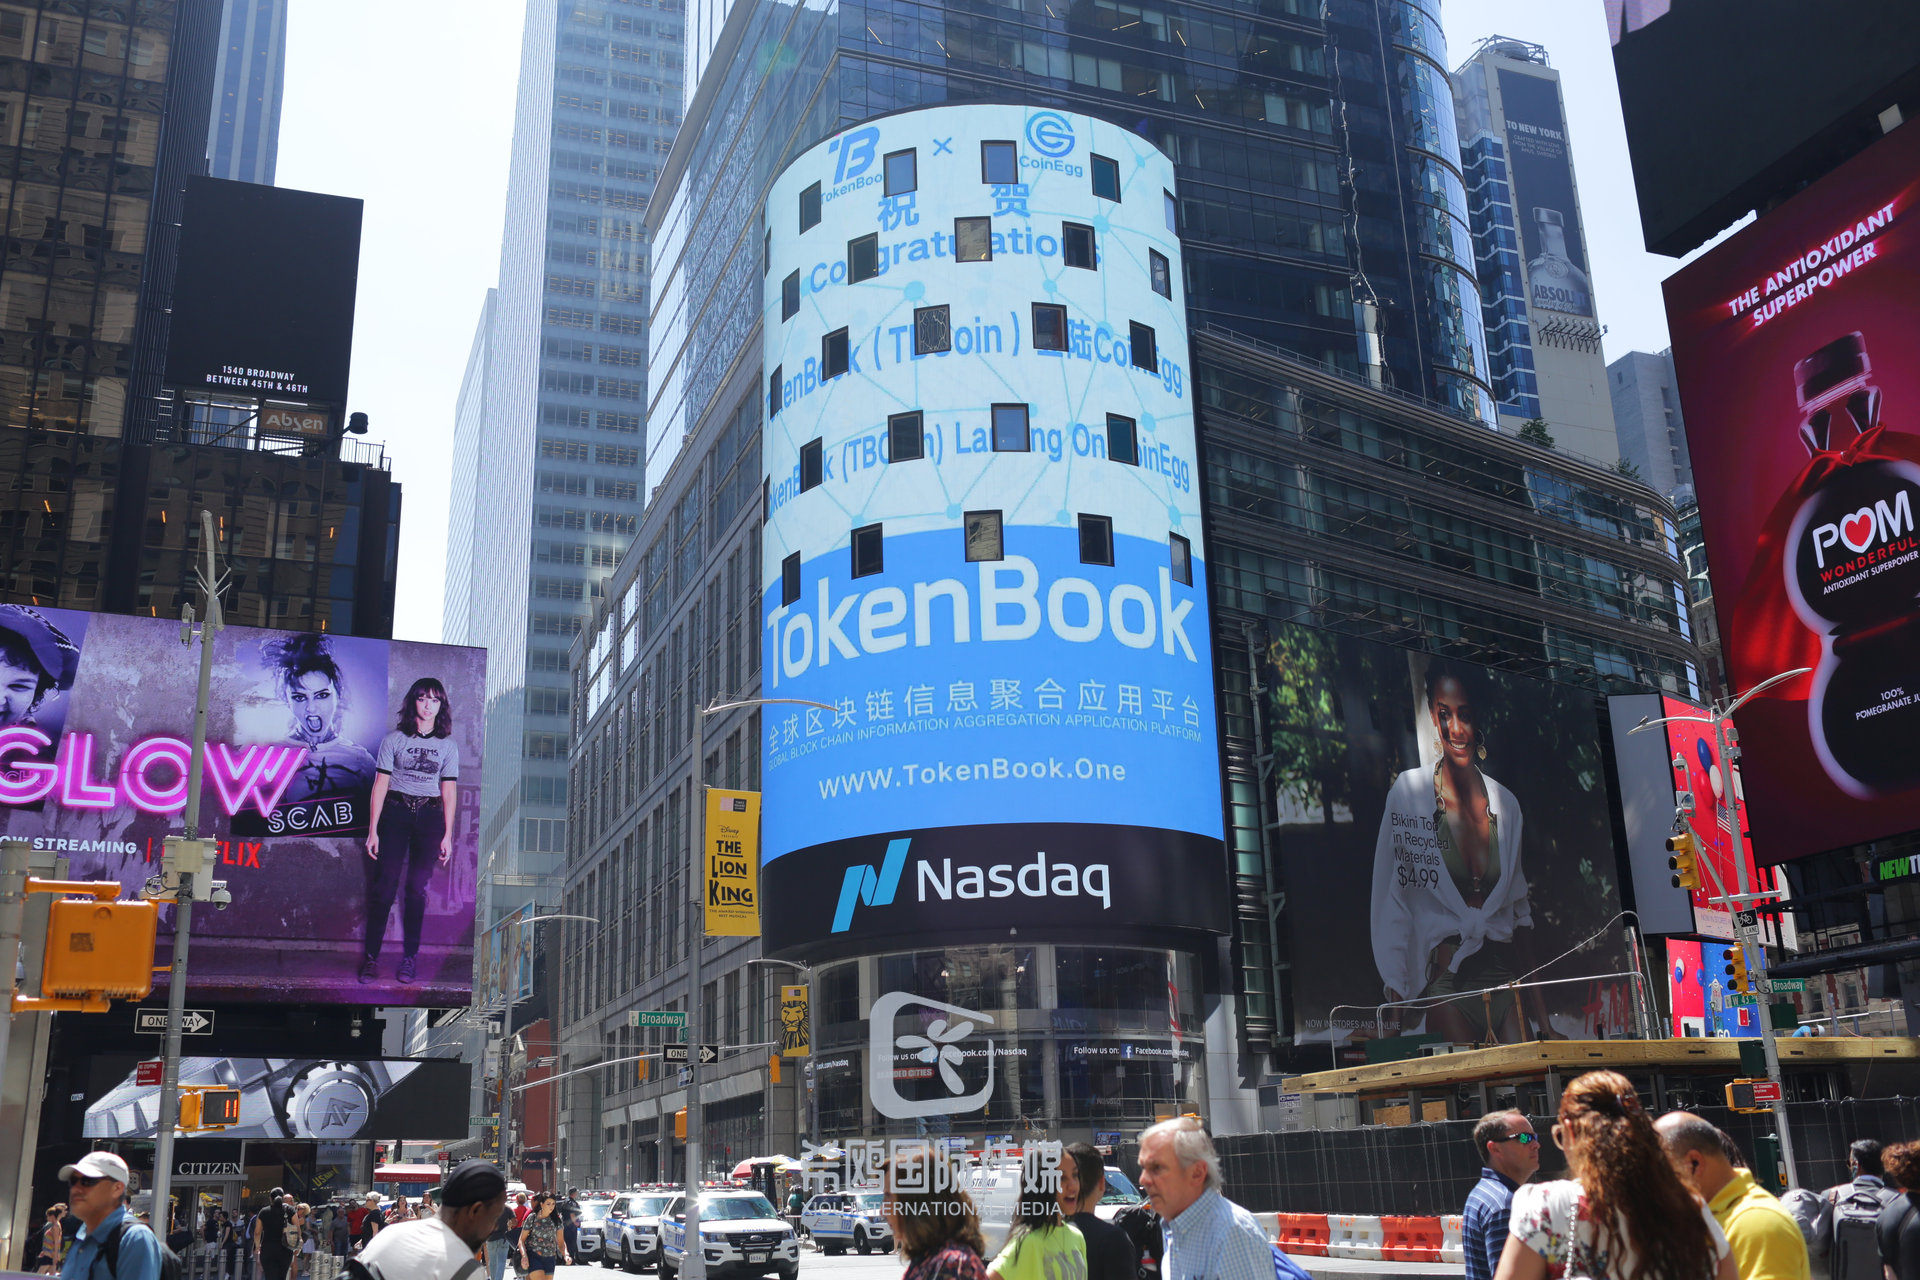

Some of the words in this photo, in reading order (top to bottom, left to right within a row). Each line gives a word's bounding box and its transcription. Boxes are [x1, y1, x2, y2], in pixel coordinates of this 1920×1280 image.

[1518, 122, 1537, 135] NEW
[1019, 155, 1084, 178] CoinEgg
[821, 172, 883, 205] TokenBoo
[1728, 286, 1760, 317] THE
[1765, 202, 1895, 297] ANTIOXIDANT
[1752, 242, 1878, 327] SUPERPOWER
[206, 374, 249, 387] BETWEEN
[251, 378, 274, 390] 45TH
[276, 382, 283, 391] &
[285, 382, 308, 393] 46TH
[222, 364, 244, 376] 1540
[247, 367, 295, 381] BROADWAY
[266, 412, 323, 431] Absen
[1072, 423, 1106, 460] On
[1820, 536, 1918, 583] WONDERFUL
[1823, 569, 1870, 595] ANTIOXIDANT
[1870, 550, 1919, 576] SUPERPOWER
[767, 554, 1198, 690] TokenBook
[1880, 686, 1905, 701] 100%
[768, 677, 1200, 756] 全球区块链信息聚合应用平台
[1855, 695, 1912, 721] POMEGRANATE
[768, 754, 790, 772] GLOBAL
[790, 739, 818, 760] BLOCK
[820, 731, 854, 749] CHAIN
[857, 716, 950, 741] INFORMATION
[953, 713, 1061, 729] AGGREGATION
[1065, 714, 1148, 733] APPLICATION
[1151, 721, 1202, 744] PLATFORM
[0, 726, 308, 818] GLOW
[267, 801, 354, 834] SCAB
[1391, 812, 1419, 830] Bikini
[1420, 816, 1439, 835] Top
[33, 836, 138, 854] STREAMING
[716, 840, 742, 854] THE
[1392, 830, 1403, 844] in
[1404, 832, 1449, 850] Recycled
[711, 855, 747, 879] LION
[1394, 847, 1440, 866] Materials
[917, 850, 1111, 910] Nasdaq
[1397, 864, 1440, 890] $4.99
[709, 879, 753, 907] KING
[1773, 981, 1803, 992] Broadway
[147, 1016, 168, 1026] ONE
[641, 1013, 684, 1027] Broadway
[1305, 1019, 1322, 1028] NOW
[671, 1050, 687, 1058] ONE
[1073, 1046, 1098, 1055] Follow
[1099, 1047, 1108, 1055] us
[908, 1068, 933, 1078] CITIES
[178, 1162, 244, 1176] CITIZEN
